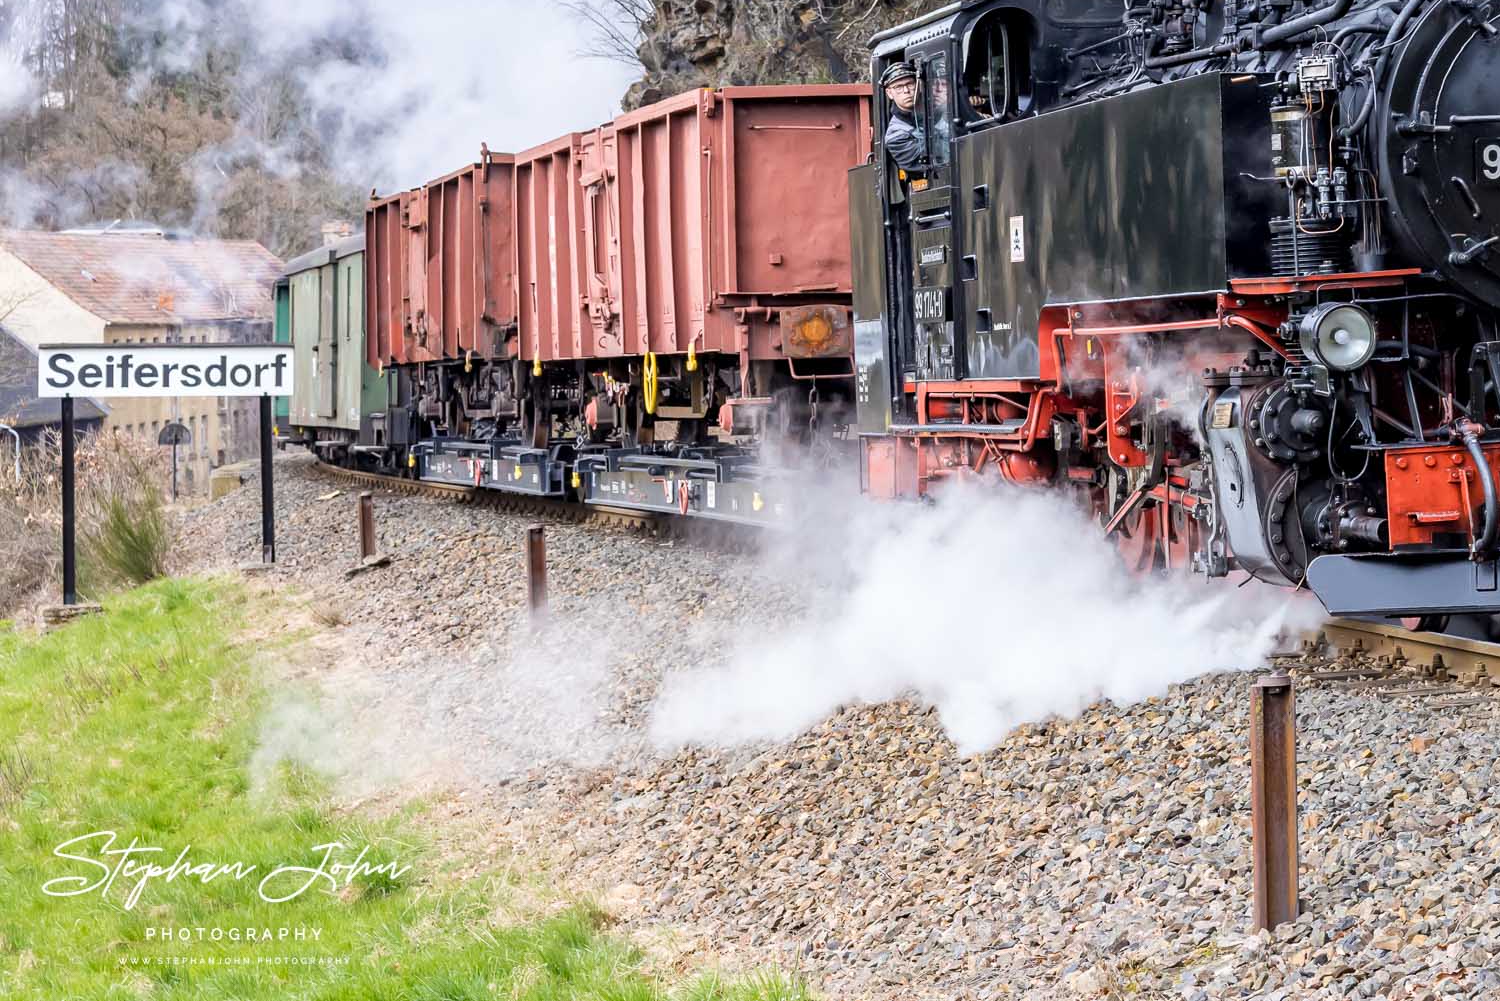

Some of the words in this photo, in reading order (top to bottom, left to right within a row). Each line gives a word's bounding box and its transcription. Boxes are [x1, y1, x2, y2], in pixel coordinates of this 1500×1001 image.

[914, 290, 923, 319] 99
[923, 288, 943, 318] 1741-0
[45, 352, 287, 388] Seifersdorf
